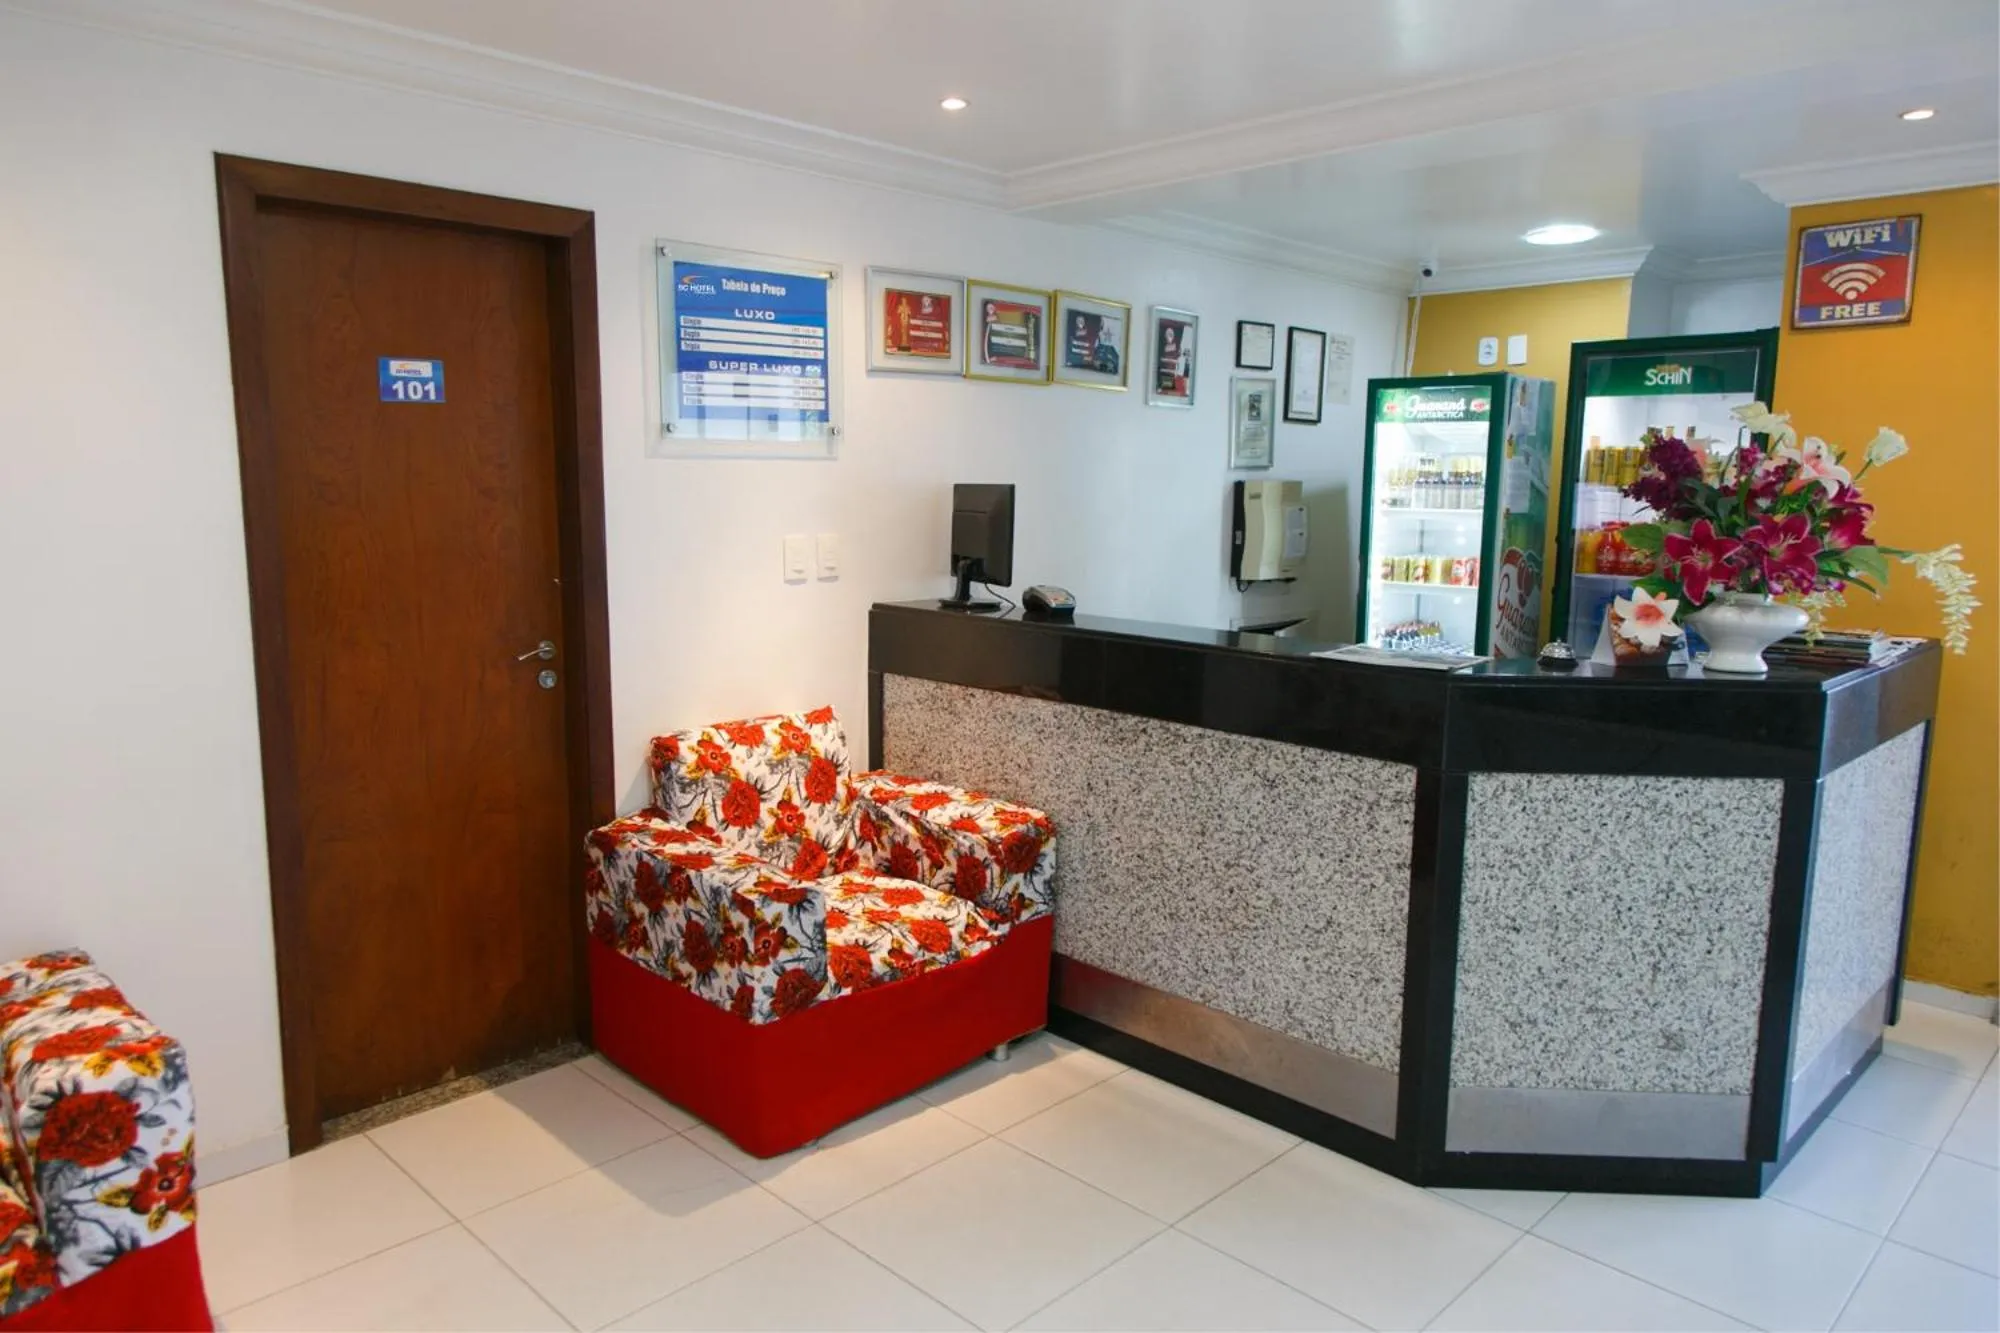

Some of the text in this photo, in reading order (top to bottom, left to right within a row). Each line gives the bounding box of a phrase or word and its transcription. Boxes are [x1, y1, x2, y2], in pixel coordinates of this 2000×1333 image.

[1824, 223, 1891, 248] WiFi
[690, 284, 715, 292] HOTEL
[721, 278, 749, 292] Tabela
[750, 282, 761, 293] de
[735, 308, 776, 321] LUXO
[1820, 302, 1882, 320] FREE
[708, 360, 802, 374] SUPER LUXO
[392, 380, 436, 400] 101
